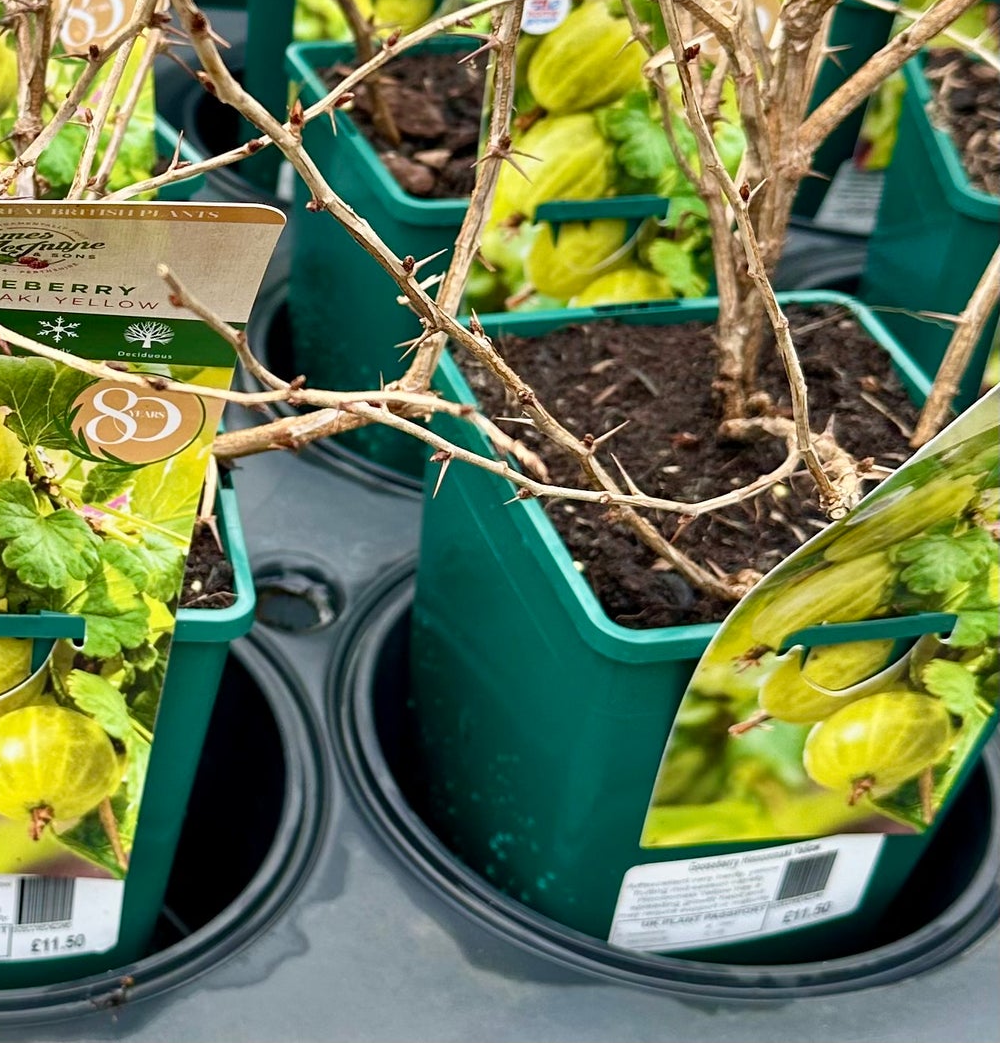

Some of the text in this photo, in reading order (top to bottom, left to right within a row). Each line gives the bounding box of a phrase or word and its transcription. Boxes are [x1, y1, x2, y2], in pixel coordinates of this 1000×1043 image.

[51, 208, 135, 217] BRITISH
[140, 210, 220, 219] PLANTS
[55, 296, 160, 311] YELLOW
[117, 350, 173, 359] Deciduous
[85, 387, 183, 445] 80
[129, 410, 166, 419] YEARS
[31, 933, 86, 952] £11.50
